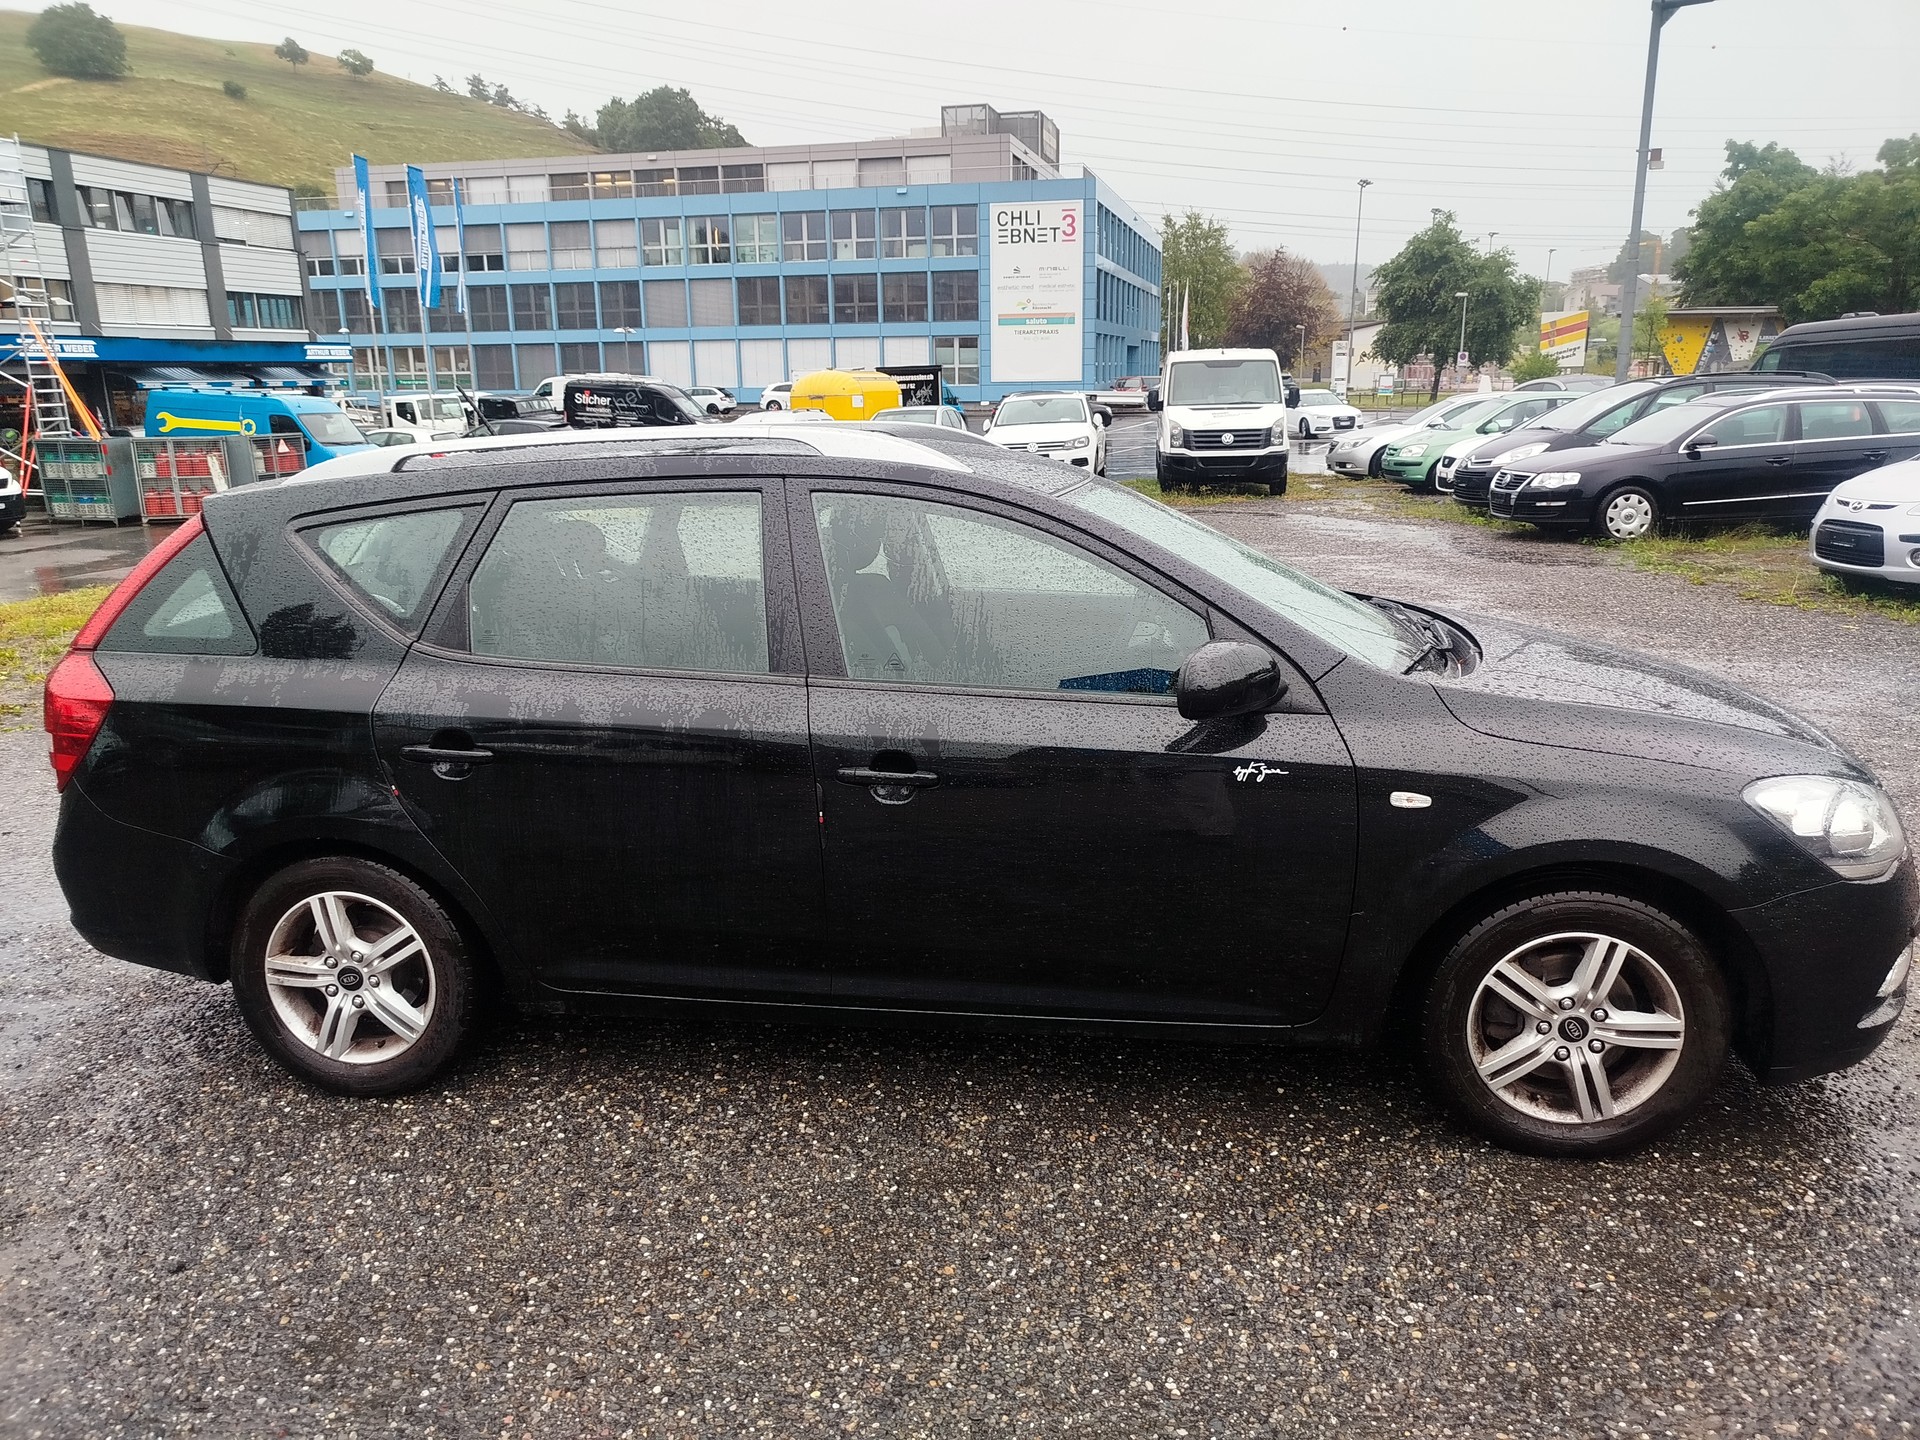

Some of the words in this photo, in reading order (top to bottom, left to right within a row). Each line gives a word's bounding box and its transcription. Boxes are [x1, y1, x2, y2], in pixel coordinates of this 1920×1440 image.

[997, 210, 1040, 227] CHLI
[998, 227, 1060, 244] EBNET
[1062, 213, 1076, 237] 3
[1025, 317, 1048, 325] saluto
[63, 344, 95, 353] WEBER
[574, 392, 612, 406] Sticher
